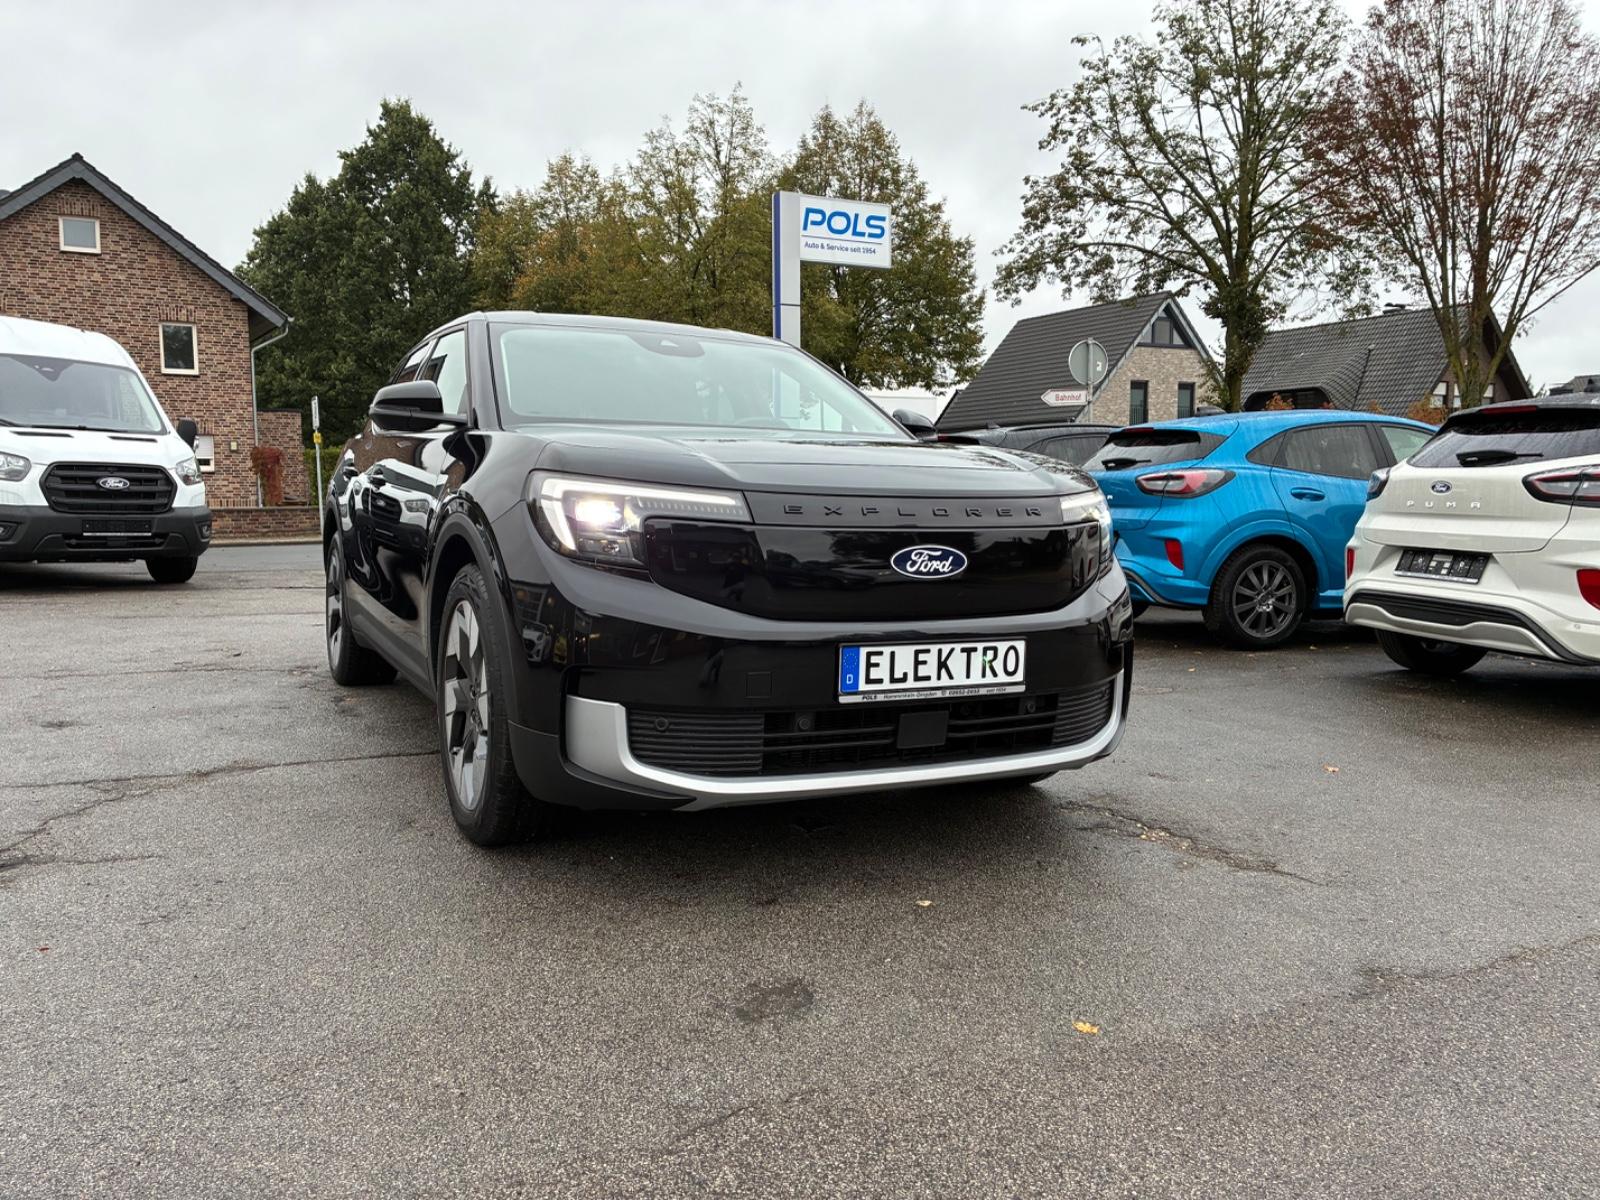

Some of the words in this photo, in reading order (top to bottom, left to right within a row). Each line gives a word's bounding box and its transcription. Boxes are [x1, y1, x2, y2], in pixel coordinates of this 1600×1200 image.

[802, 207, 887, 239] POLS
[804, 241, 819, 249] Auto
[826, 243, 849, 252] Service
[862, 247, 876, 255] 1954
[1055, 393, 1082, 401] Bahnhof
[783, 503, 1043, 518] EXPLORER
[1406, 500, 1481, 510] PUMA
[905, 549, 954, 574] Ford
[846, 674, 854, 685] D
[864, 645, 1020, 685] ELEKTRO
